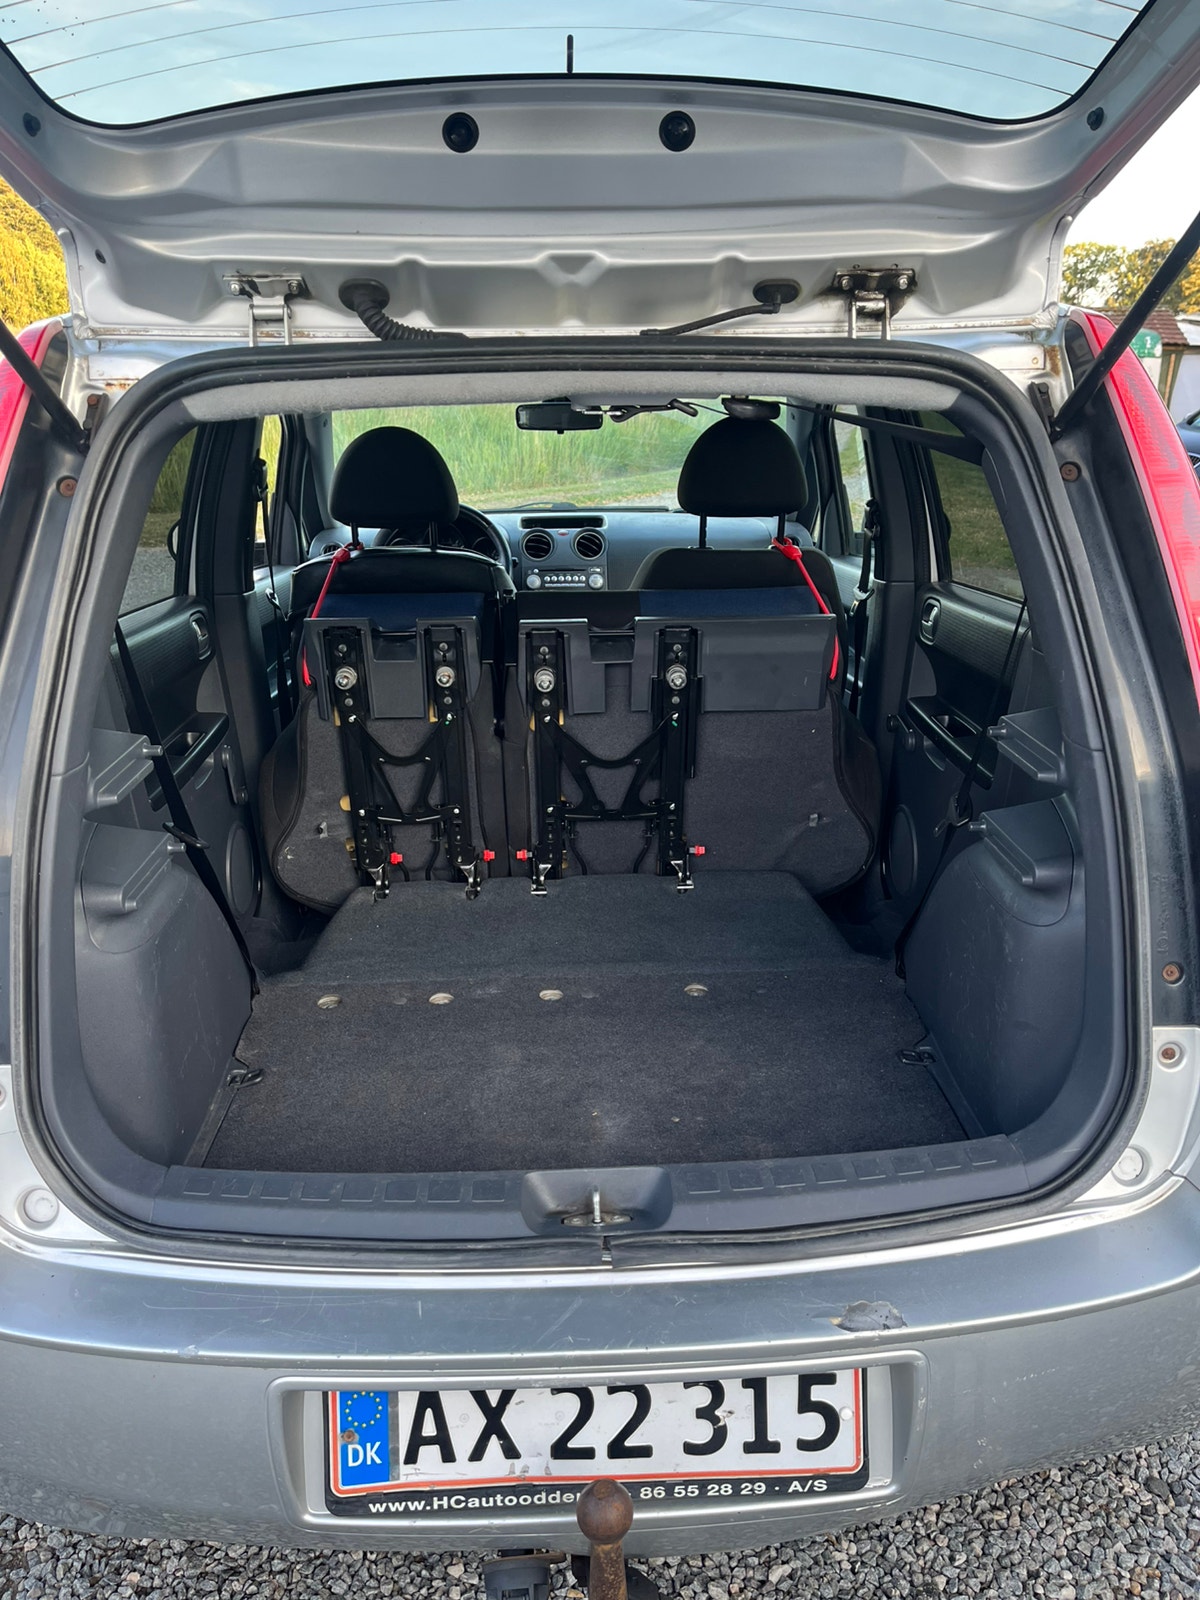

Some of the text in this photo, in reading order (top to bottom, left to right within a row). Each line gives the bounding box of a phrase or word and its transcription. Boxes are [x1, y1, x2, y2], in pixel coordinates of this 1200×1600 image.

[404, 1372, 840, 1465] AX 22 315
[347, 1442, 383, 1467] DK
[640, 1486, 666, 1499] 86
[673, 1485, 699, 1498] 55
[706, 1483, 733, 1496] 28
[740, 1482, 767, 1495] 29
[787, 1479, 828, 1493] A/S
